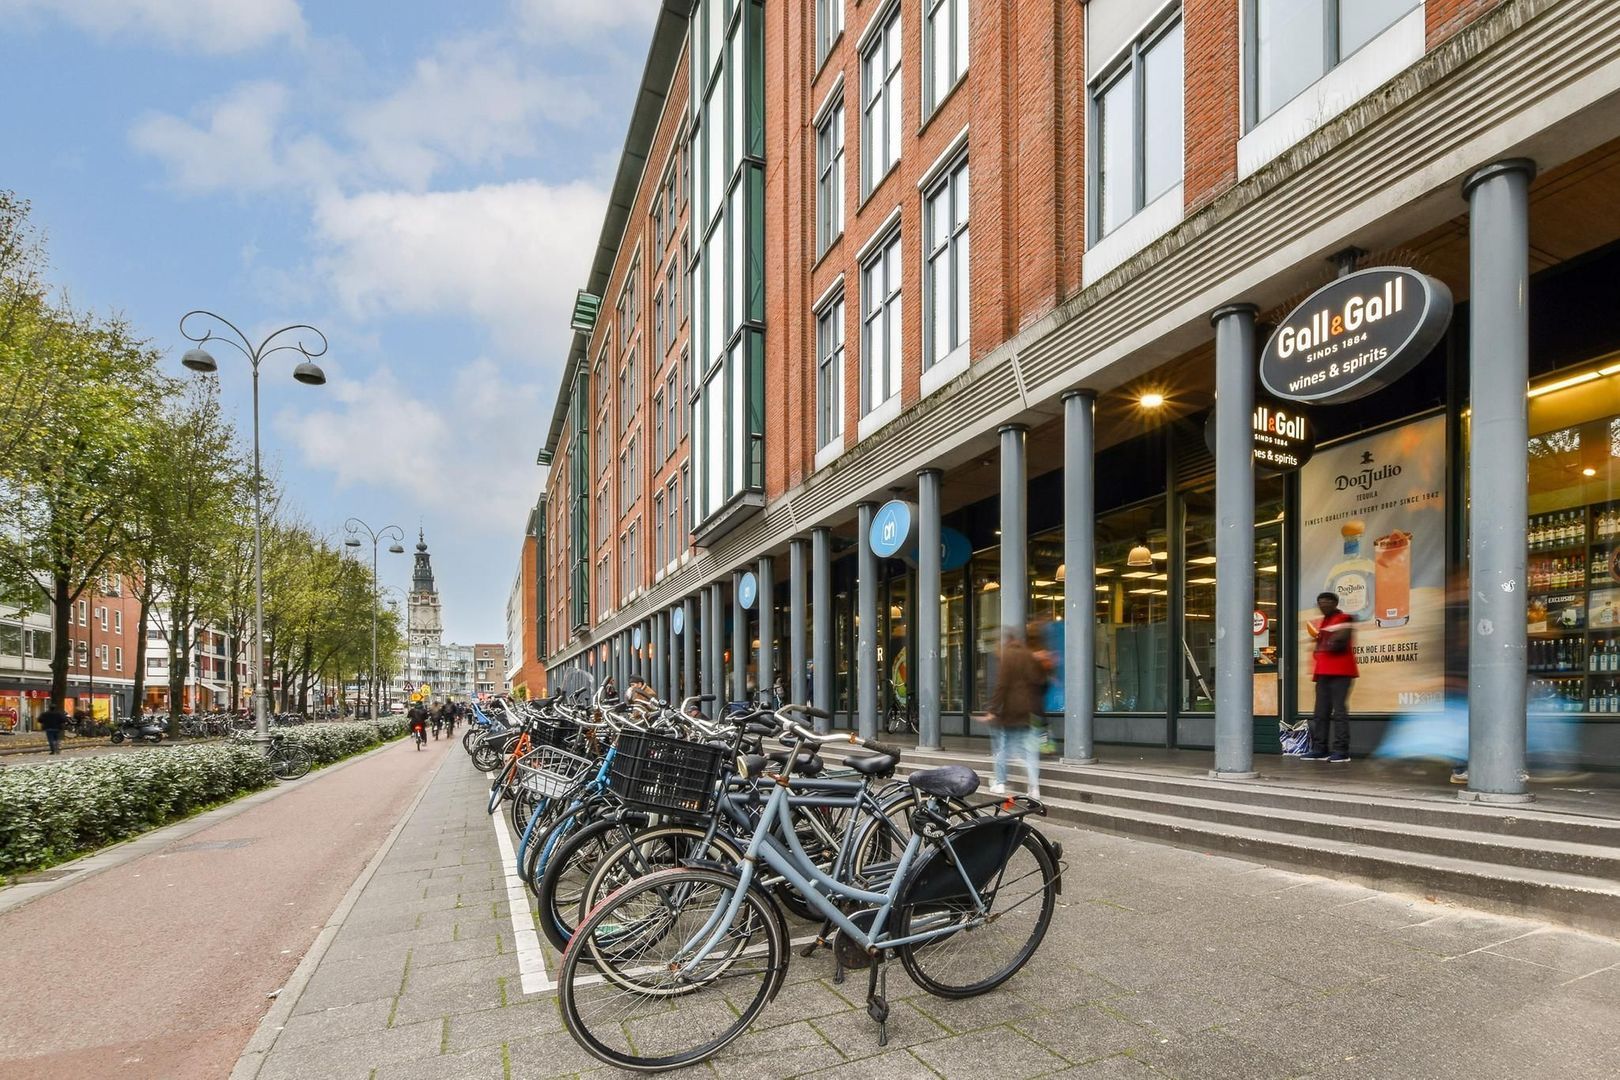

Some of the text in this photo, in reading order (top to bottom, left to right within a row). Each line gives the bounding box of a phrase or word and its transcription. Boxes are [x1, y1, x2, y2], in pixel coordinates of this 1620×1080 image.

[1278, 276, 1403, 358] Gall&Gall
[1306, 332, 1368, 363] SINDS 1884
[1289, 347, 1388, 392] wines & spirits
[1253, 406, 1305, 440] ll&Gall
[1254, 433, 1288, 446] SINDS 1884
[1253, 449, 1298, 466] nes & spirits
[1356, 490, 1378, 501] TEQUILA
[1304, 490, 1440, 527] FINEST QUALITY IN EVERY DROP SINCE 1942
[1366, 644, 1378, 654] HOE
[1379, 644, 1386, 653] JE
[1387, 643, 1395, 652] DE
[1397, 642, 1418, 651] BESTE
[1370, 654, 1394, 664] PALOMA
[1396, 653, 1418, 662] MAAKT
